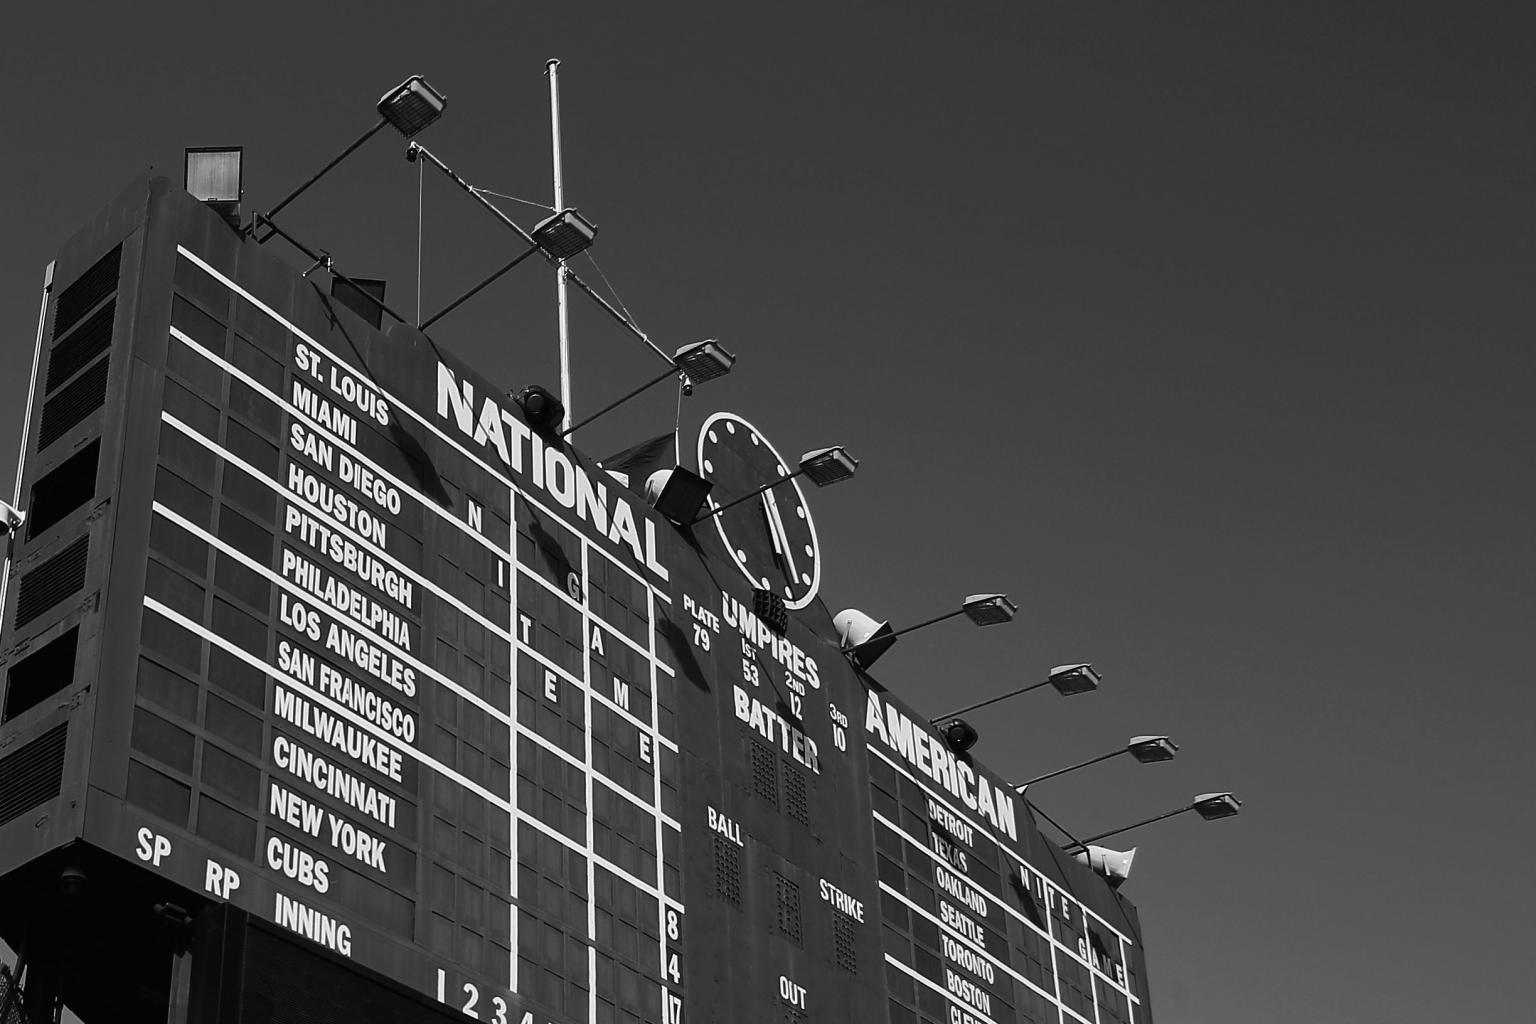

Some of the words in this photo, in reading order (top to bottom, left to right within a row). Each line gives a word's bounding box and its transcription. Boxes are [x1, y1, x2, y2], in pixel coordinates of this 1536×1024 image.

[295, 343, 324, 383] ST.
[330, 366, 389, 426] LOUIS
[293, 380, 357, 446] MIAMI
[290, 423, 333, 472] SAN
[339, 453, 401, 516] DIEGO
[437, 360, 669, 582] NATIONAL
[288, 462, 386, 550] HOUSTON
[285, 504, 413, 610] PITTSBURGH
[282, 548, 411, 651] PHILADELPHIA
[683, 593, 720, 634] PLATE
[280, 593, 321, 641] LOS
[325, 622, 416, 697] ANGELES
[692, 622, 710, 652] 79
[722, 590, 821, 689] UMPIRES
[278, 641, 315, 687] SAN
[319, 663, 415, 743] FRANCISCO
[742, 658, 760, 687] 53
[784, 671, 806, 697] 2ND
[733, 684, 821, 775] BATTER
[789, 692, 803, 721] 12
[829, 703, 848, 729] 3RD
[274, 685, 403, 783] MILWAUKEE
[832, 723, 847, 752] 10
[273, 736, 396, 829] CINCINNATI
[865, 688, 1018, 843] AMERICAN
[270, 783, 324, 838] NEW
[328, 813, 387, 873] YORK
[707, 805, 744, 848] BALL
[928, 798, 974, 848] DETROIT
[267, 836, 329, 894] CUBS
[932, 831, 968, 873] TEXAS
[819, 878, 865, 924] STRIKE
[936, 866, 987, 918] OAKLAND
[135, 826, 172, 867] SP
[205, 859, 241, 900] RP
[274, 892, 352, 958] INNING
[438, 968, 445, 1003] 1
[462, 982, 479, 1019] 2
[667, 910, 679, 940] 8
[940, 900, 986, 948] SEATTLE
[668, 953, 680, 984] 4
[942, 934, 994, 985] TORONTO
[779, 975, 807, 1010] OUT
[946, 968, 991, 1016] BOSTON
